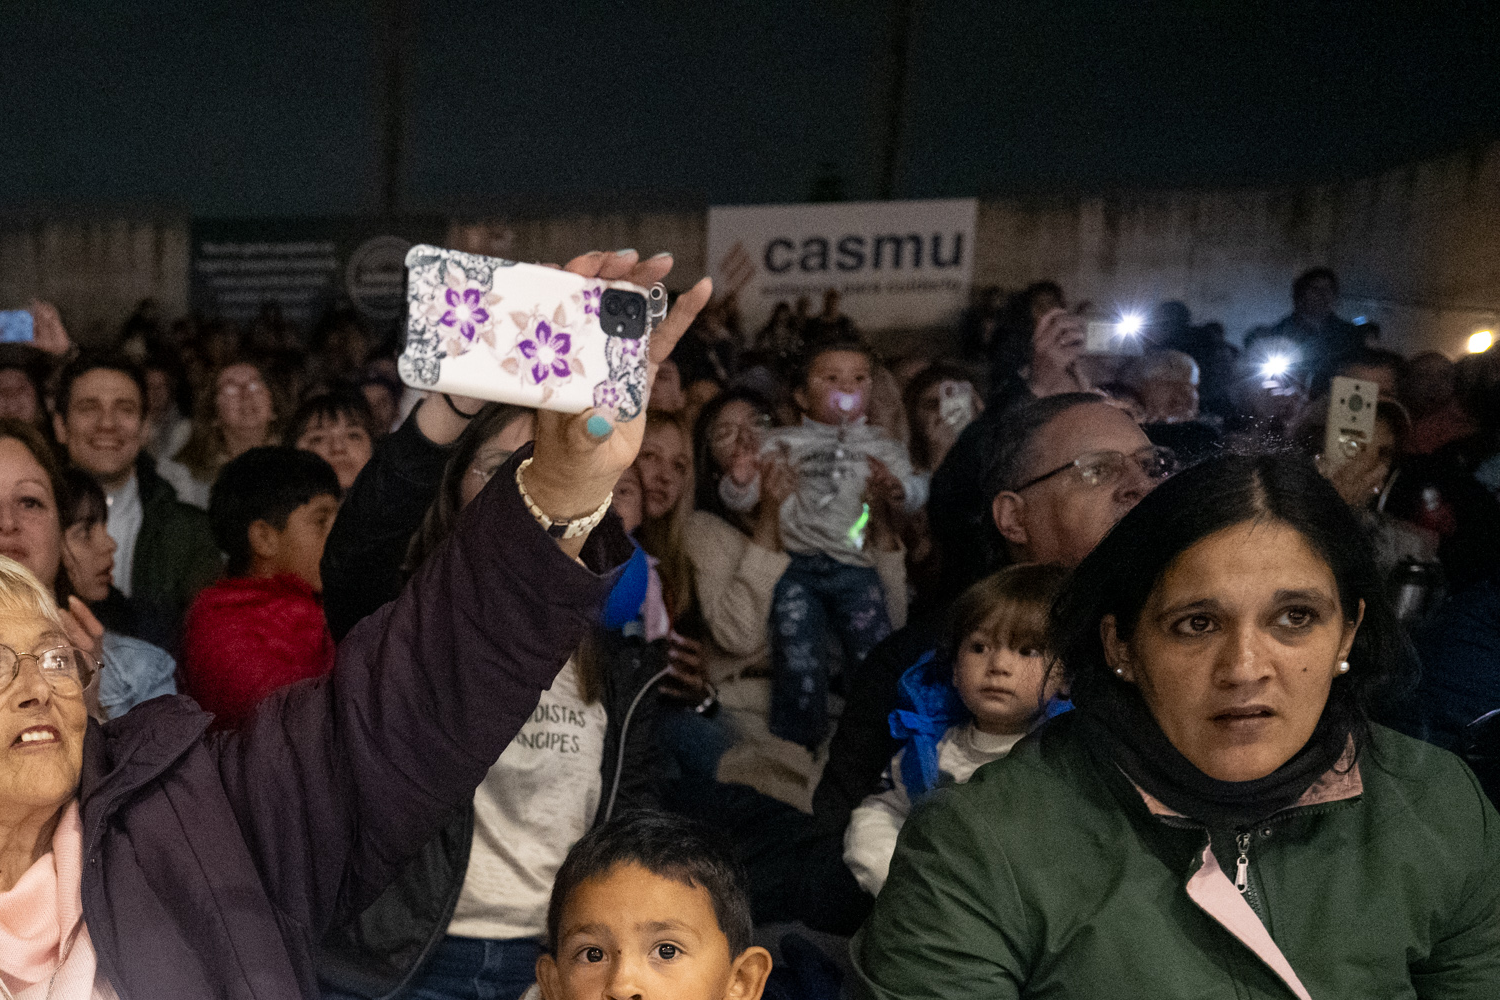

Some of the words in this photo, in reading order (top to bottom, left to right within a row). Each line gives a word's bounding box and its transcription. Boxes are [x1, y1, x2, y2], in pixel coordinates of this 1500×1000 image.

[764, 231, 962, 273] casmu
[527, 704, 586, 728] DISTAS
[516, 732, 580, 753] INCIPES
